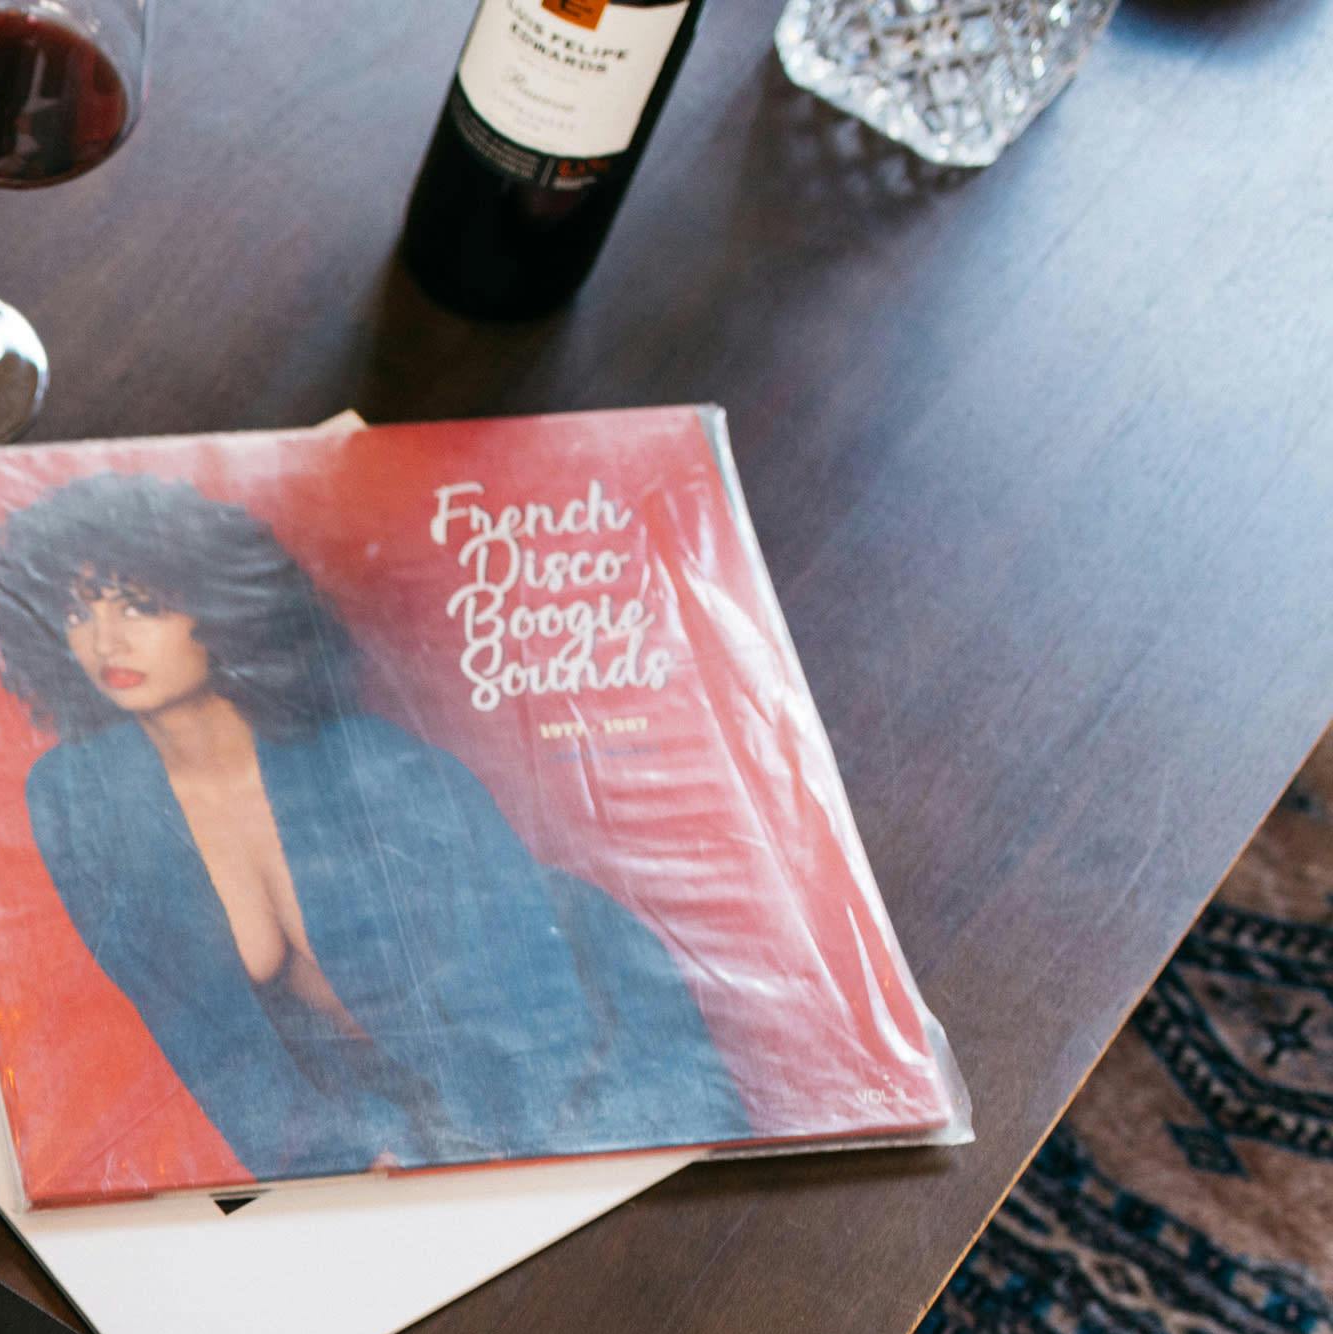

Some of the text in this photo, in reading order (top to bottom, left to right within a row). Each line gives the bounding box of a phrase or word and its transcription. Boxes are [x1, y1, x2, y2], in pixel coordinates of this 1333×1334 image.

[551, 32, 629, 60] FELIPE
[430, 478, 633, 546] French
[458, 533, 632, 594] Disco
[445, 582, 657, 668] Boogie
[459, 626, 674, 713] Sounds
